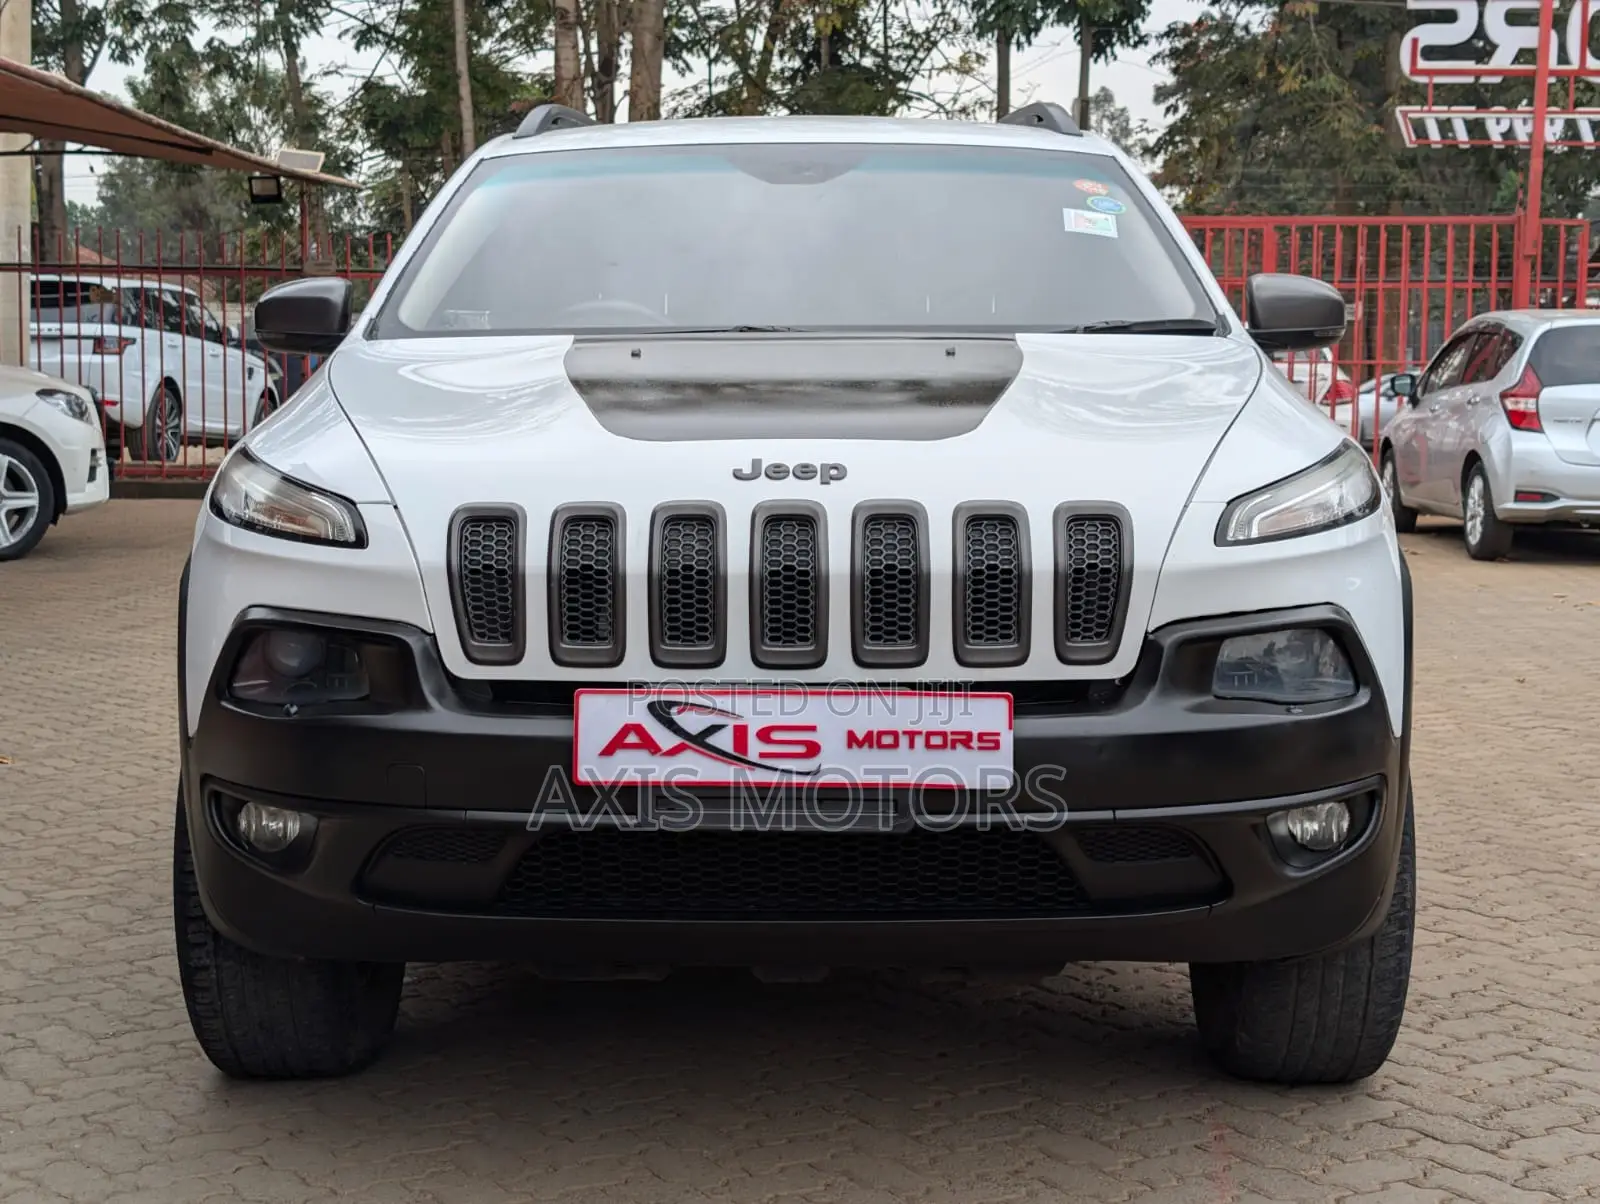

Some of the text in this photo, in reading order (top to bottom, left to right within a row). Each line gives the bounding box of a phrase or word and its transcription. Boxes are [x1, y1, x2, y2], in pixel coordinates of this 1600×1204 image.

[732, 458, 848, 485] Jeep
[598, 714, 1002, 768] AXIS MOTORS
